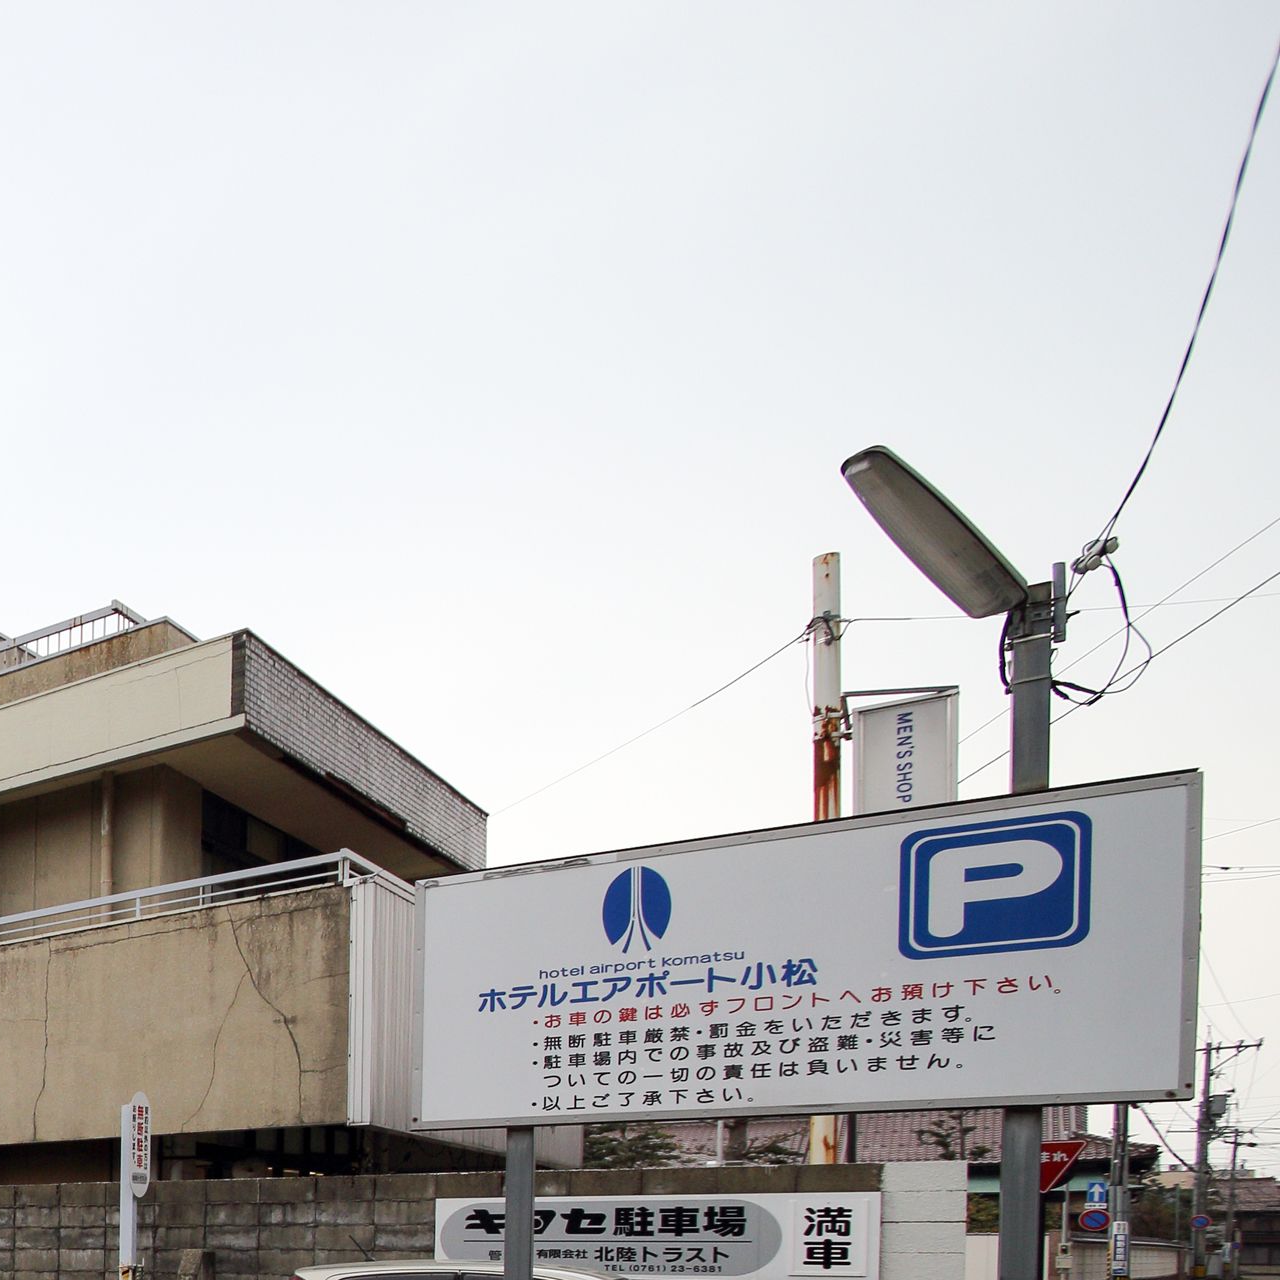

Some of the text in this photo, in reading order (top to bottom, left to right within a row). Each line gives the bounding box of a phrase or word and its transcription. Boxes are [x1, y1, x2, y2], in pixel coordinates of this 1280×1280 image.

[896, 711, 915, 804] MEN'S SHOP
[927, 839, 1064, 938] P
[478, 958, 818, 1013] ホテルエアポート小松
[539, 950, 745, 980] hotel airport komatsu
[1041, 1151, 1069, 1162] まれ
[536, 1249, 588, 1260] 有限会社
[594, 1245, 730, 1264] 北陸トラスト
[803, 1206, 853, 1270] 満車
[604, 1264, 625, 1272] TEL
